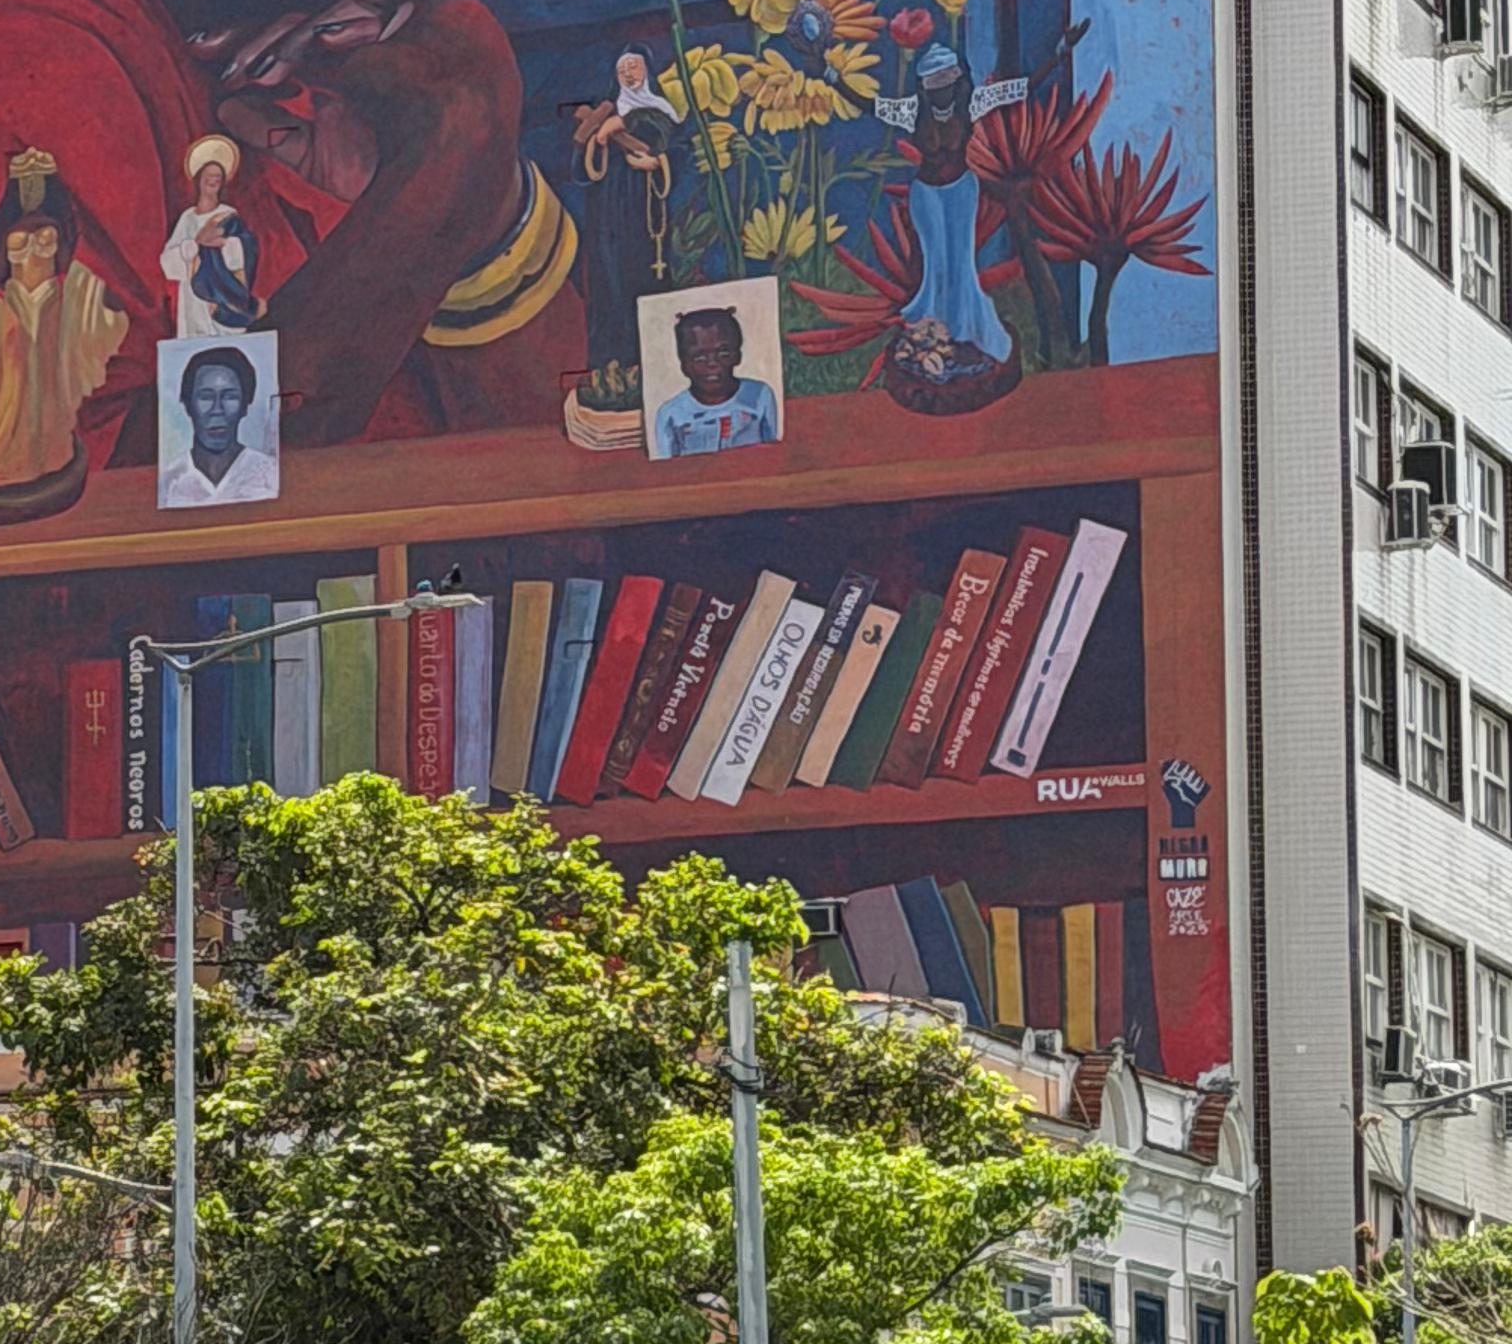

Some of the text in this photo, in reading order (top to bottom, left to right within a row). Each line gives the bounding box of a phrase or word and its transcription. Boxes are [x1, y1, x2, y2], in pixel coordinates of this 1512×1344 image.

[417, 608, 444, 679] uarto
[759, 621, 805, 692] OLHOS
[1037, 776, 1103, 803] RUA
